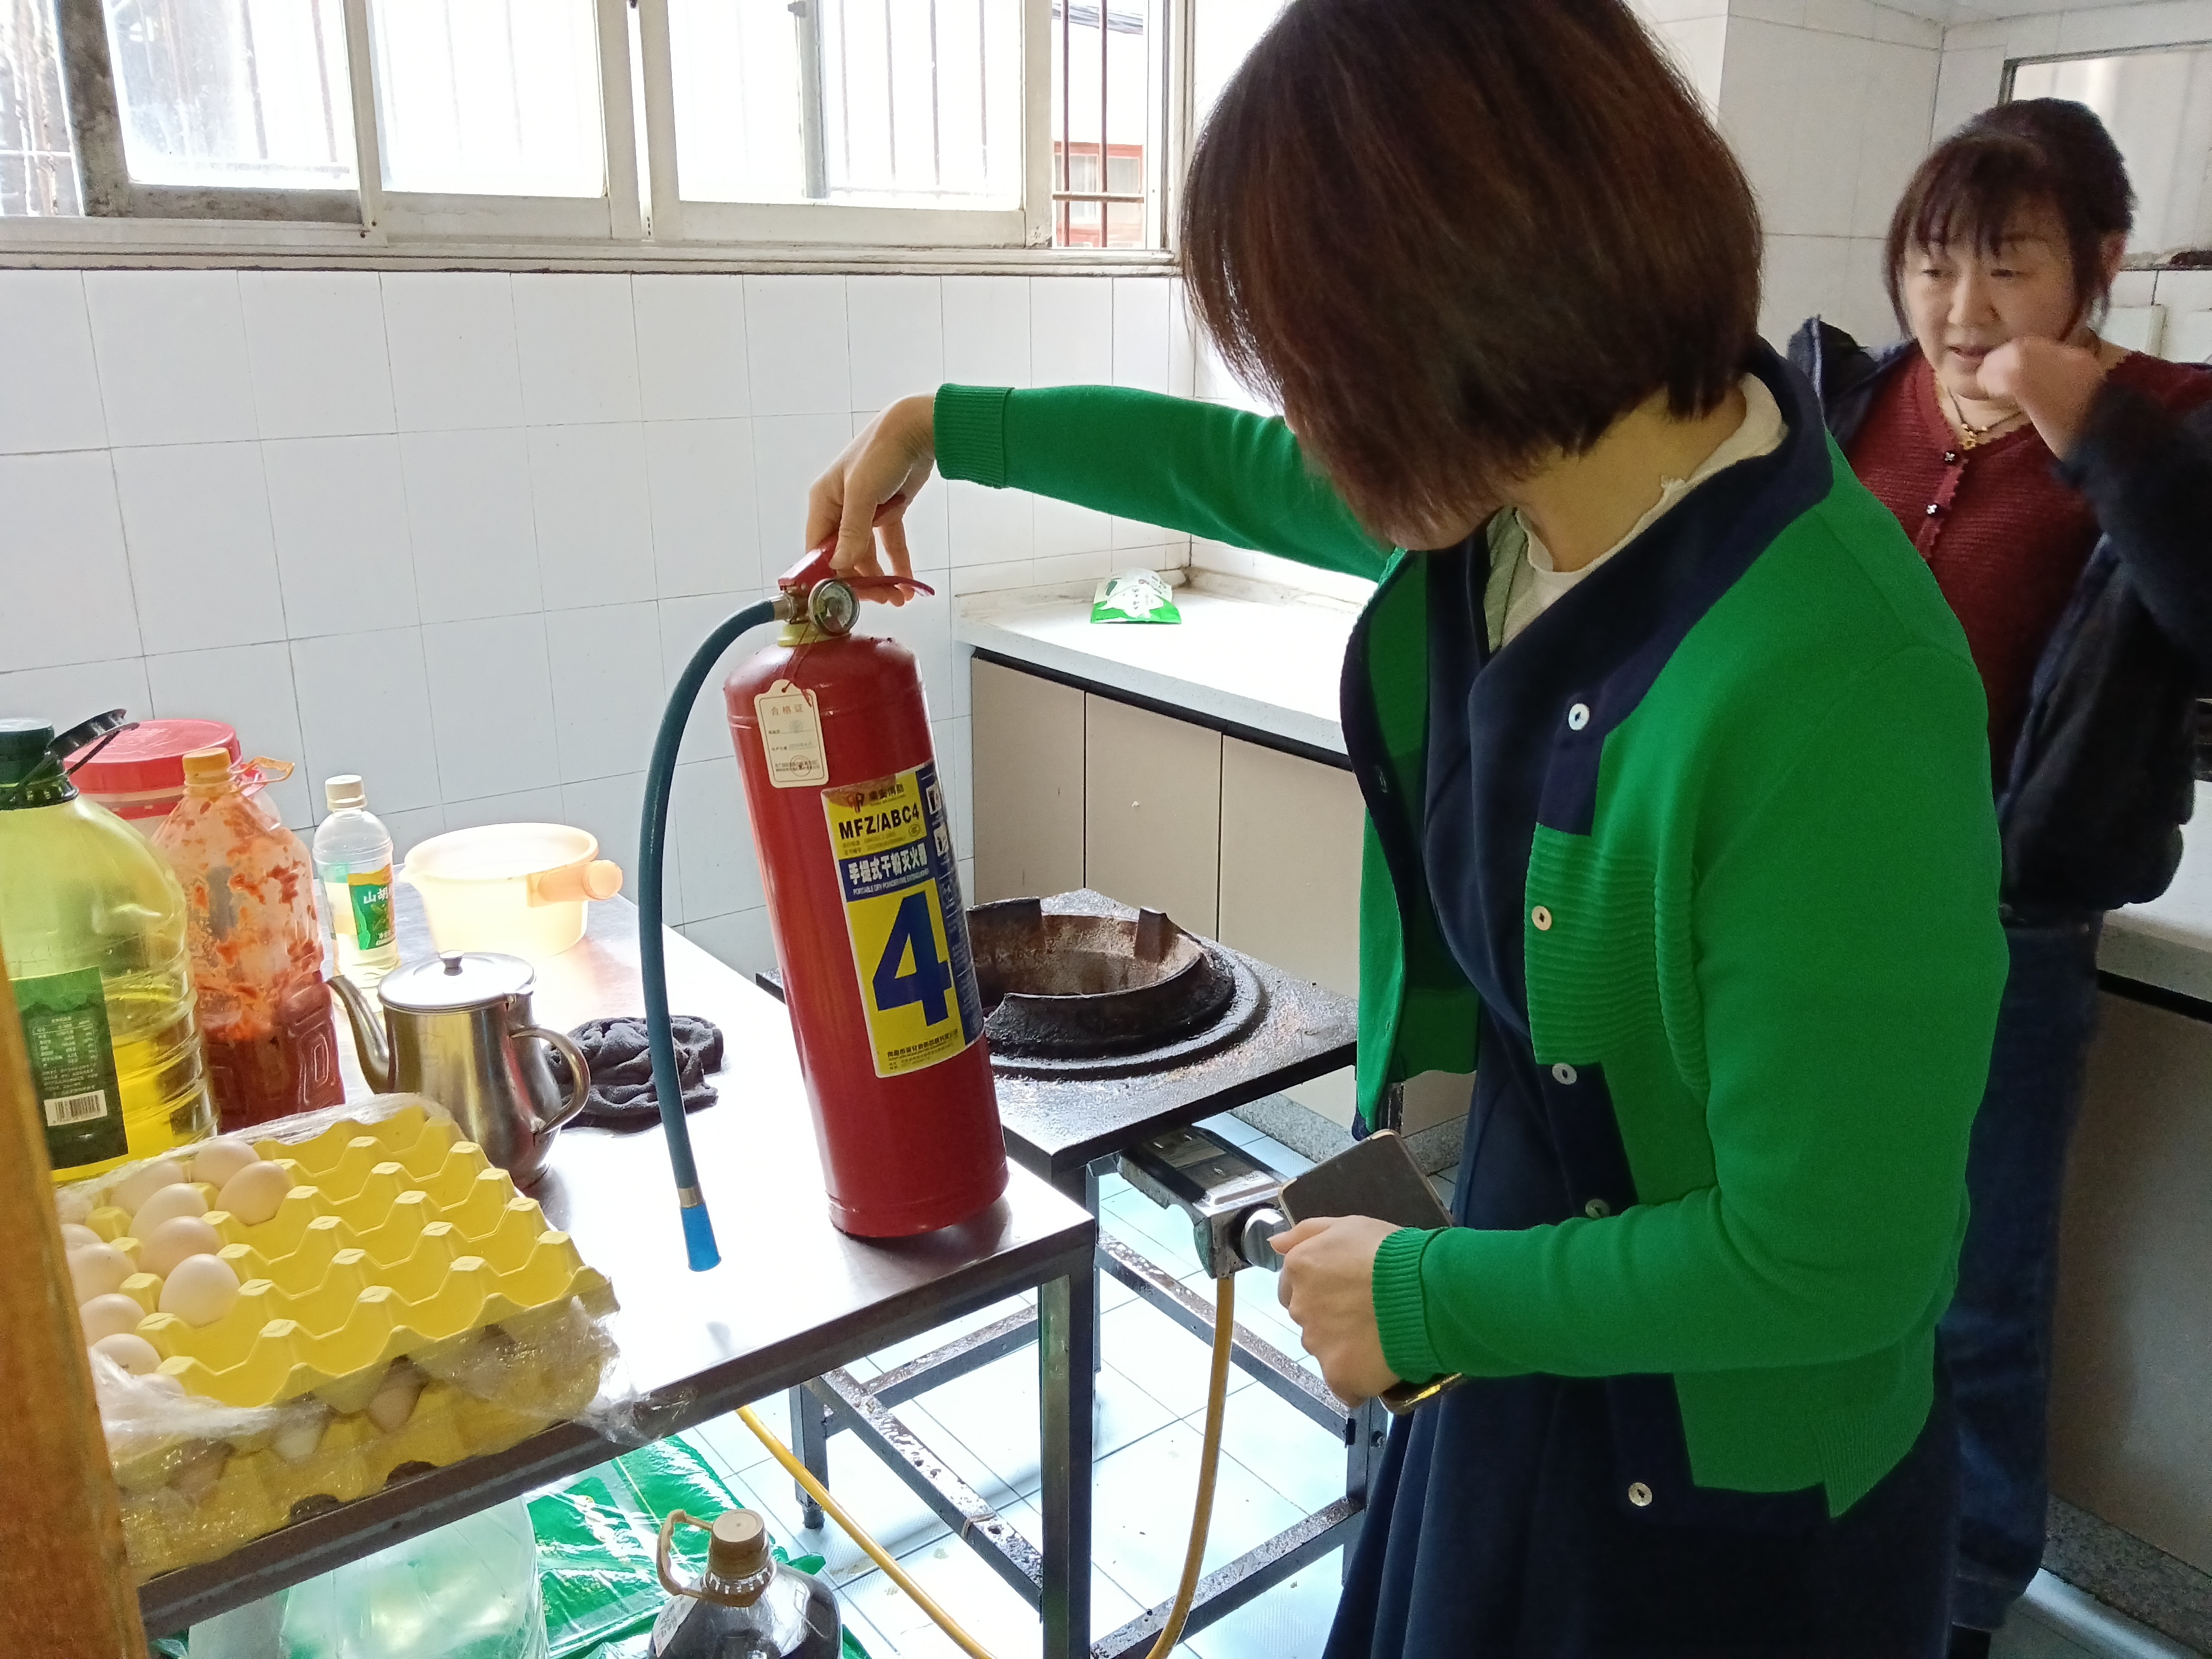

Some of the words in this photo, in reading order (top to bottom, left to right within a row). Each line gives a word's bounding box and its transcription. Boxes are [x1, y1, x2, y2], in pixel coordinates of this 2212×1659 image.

[771, 704, 803, 716] 合格证
[839, 802, 919, 840] MFZ/ABC4
[872, 891, 952, 1027] 4
